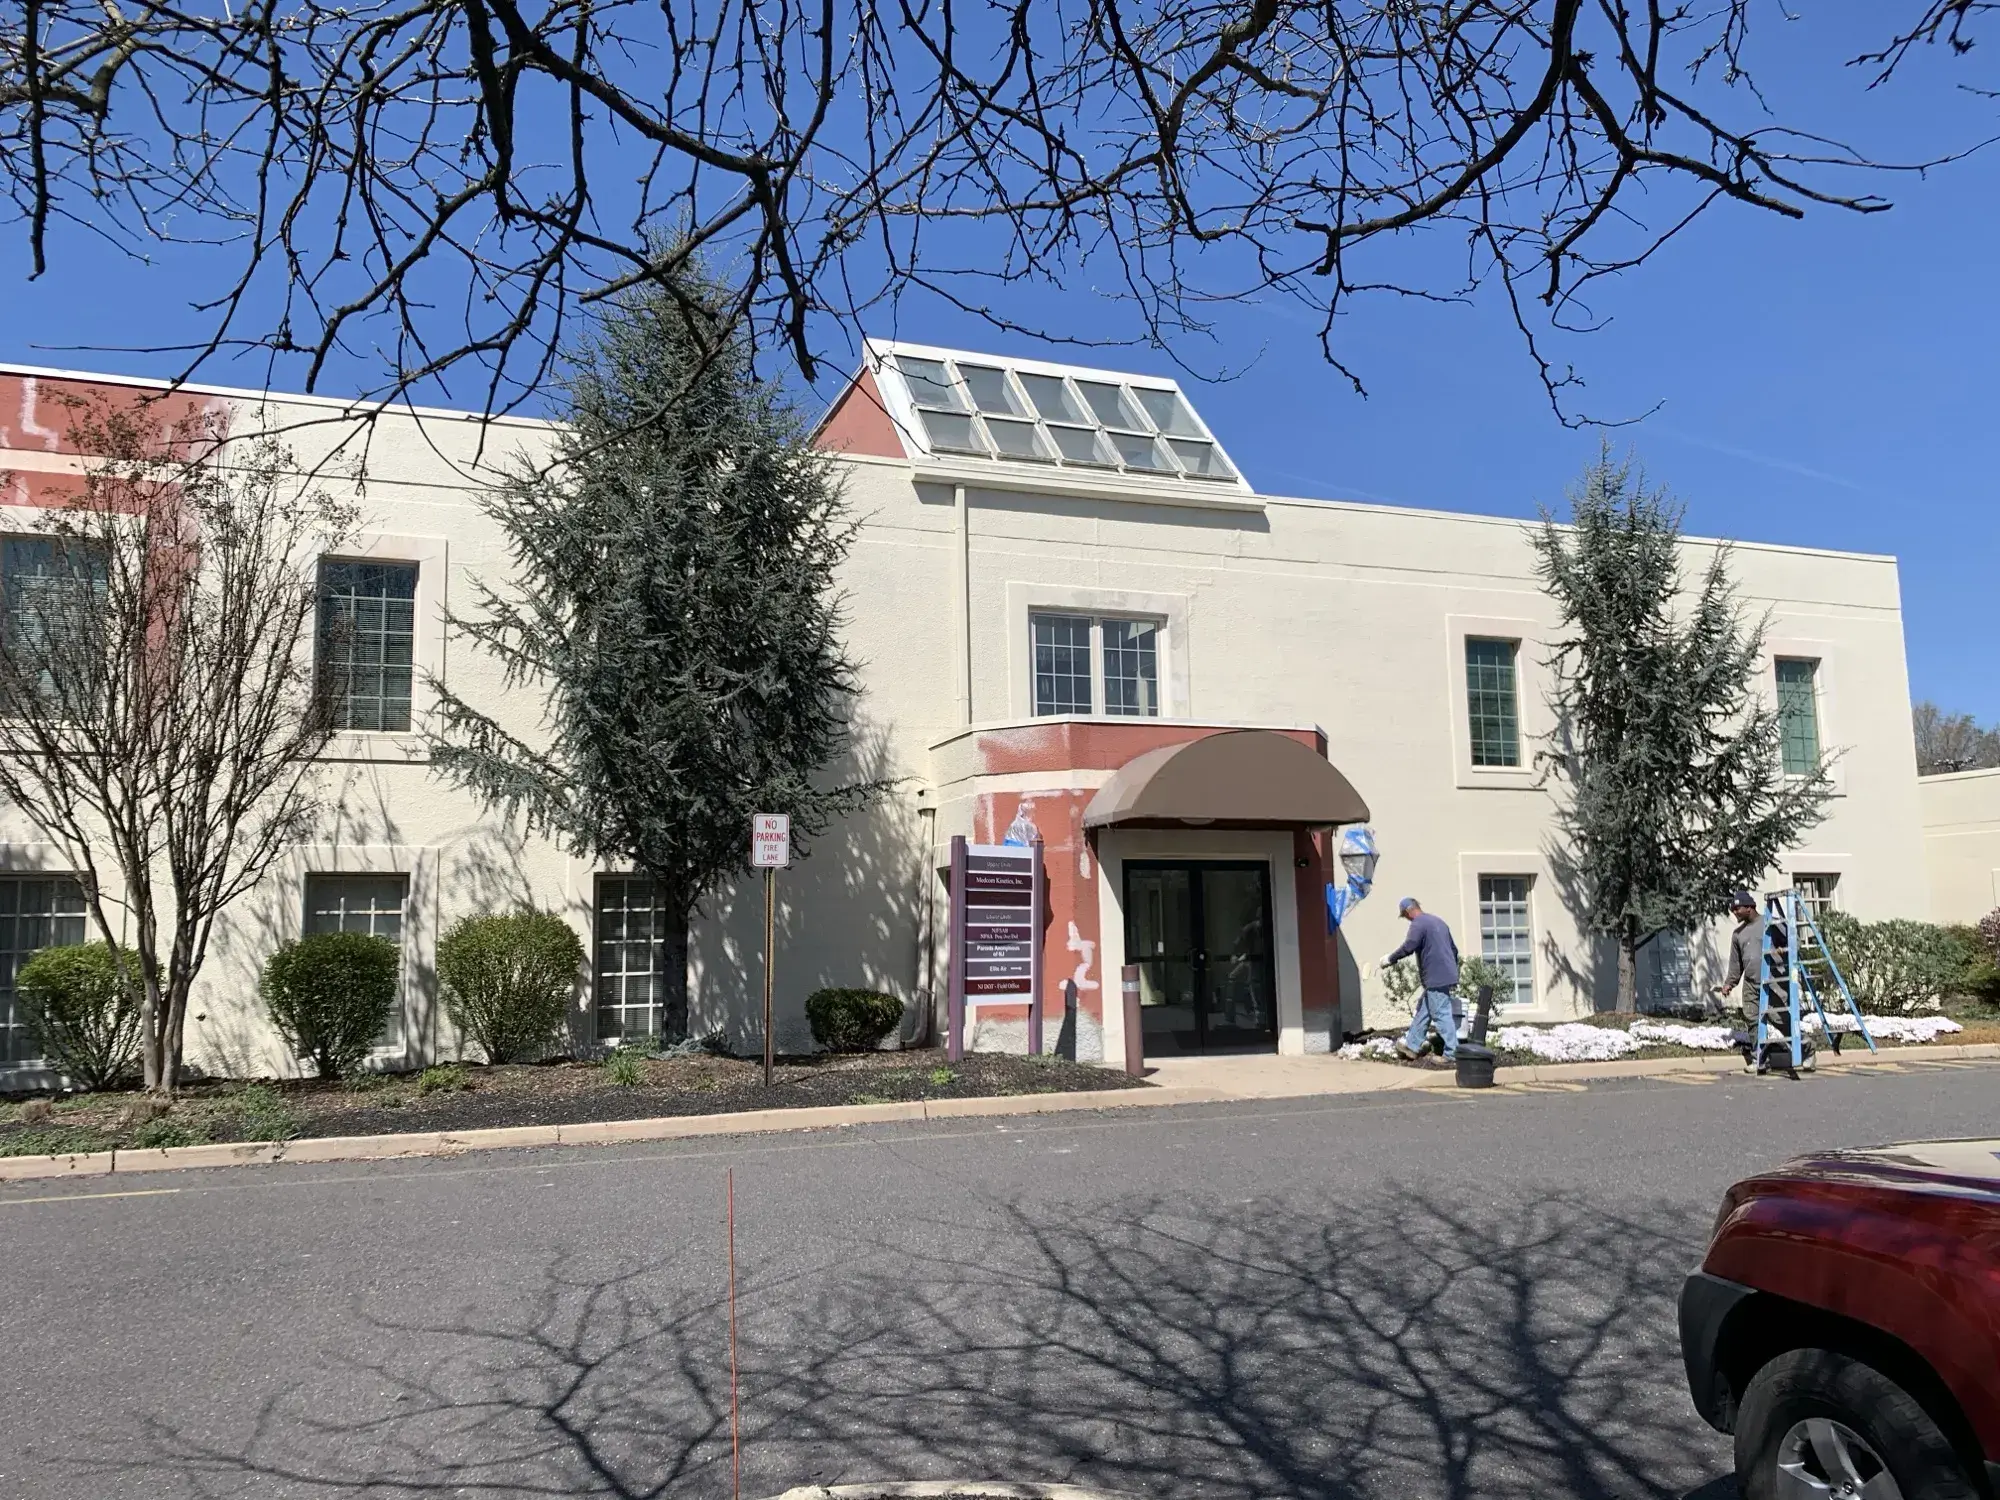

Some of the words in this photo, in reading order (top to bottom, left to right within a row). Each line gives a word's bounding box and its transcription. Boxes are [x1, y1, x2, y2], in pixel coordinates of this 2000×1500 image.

[765, 820, 777, 830] NO
[756, 832, 786, 842] PARKING
[976, 876, 995, 884] Medcom
